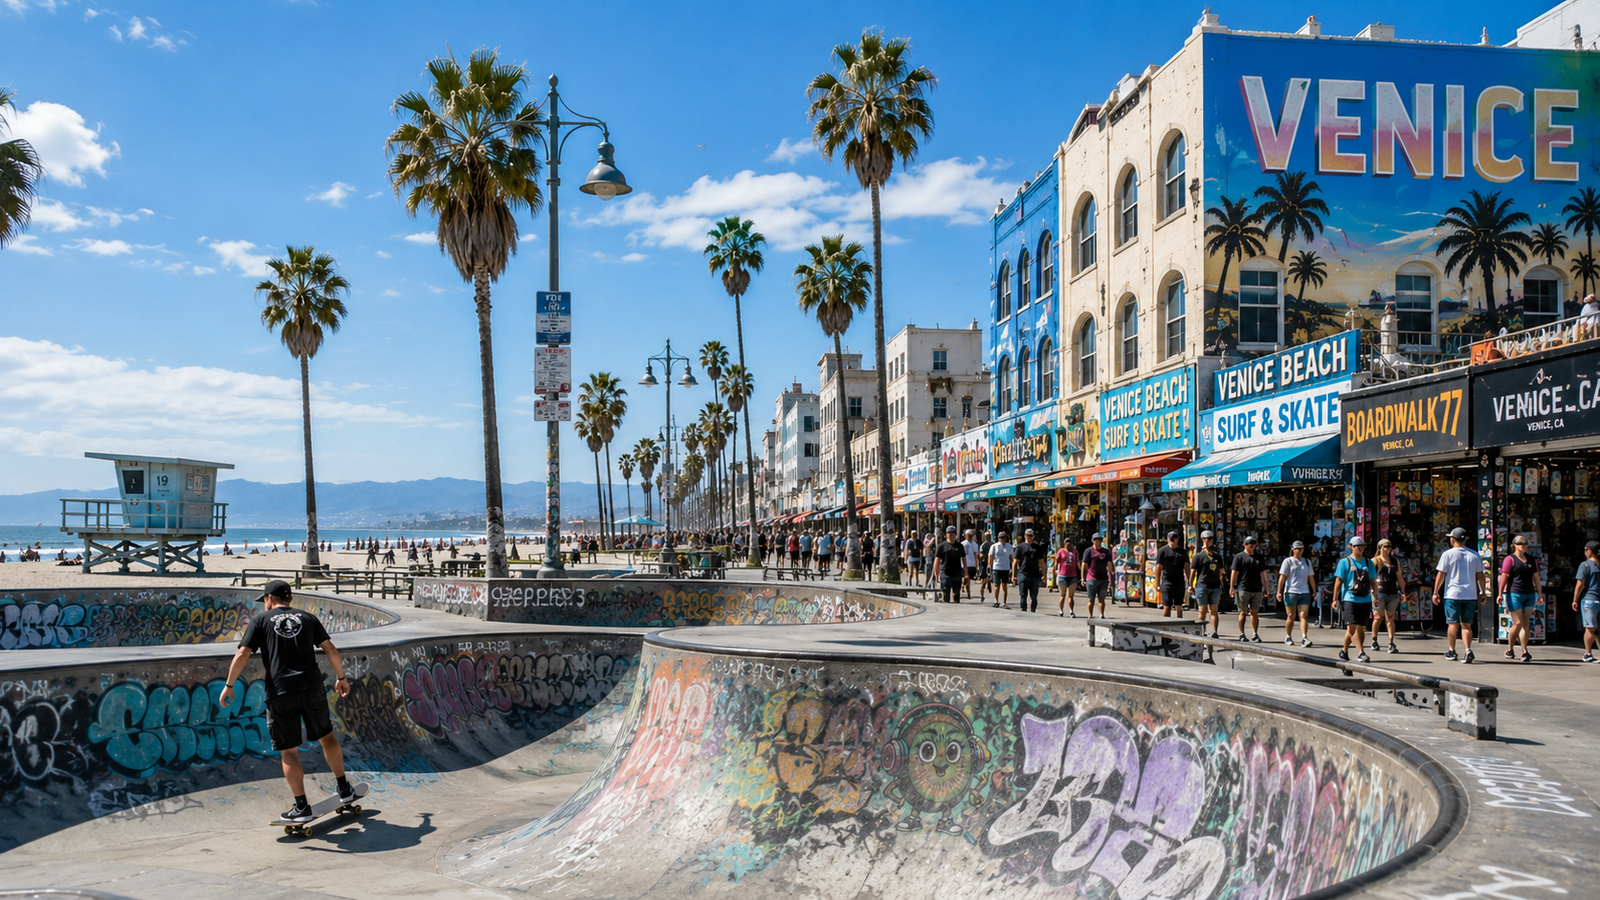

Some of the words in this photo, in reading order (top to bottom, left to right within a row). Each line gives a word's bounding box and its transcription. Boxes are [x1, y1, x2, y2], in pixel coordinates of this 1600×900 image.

[1238, 75, 1580, 183] VENICE
[1217, 359, 1275, 402] VENICE
[1280, 337, 1348, 387] BEACH
[1104, 387, 1142, 422] VENICE
[1145, 372, 1189, 413] BEACH
[1217, 410, 1257, 443] SURF
[1261, 407, 1273, 436] &
[1278, 391, 1340, 433] SKATE
[1346, 396, 1438, 448] BOARDWALK
[1440, 388, 1463, 437] 77
[1104, 423, 1130, 450] SURF
[1405, 438, 1415, 449] CA
[1554, 418, 1565, 428] CA
[156, 475, 169, 486] 19
